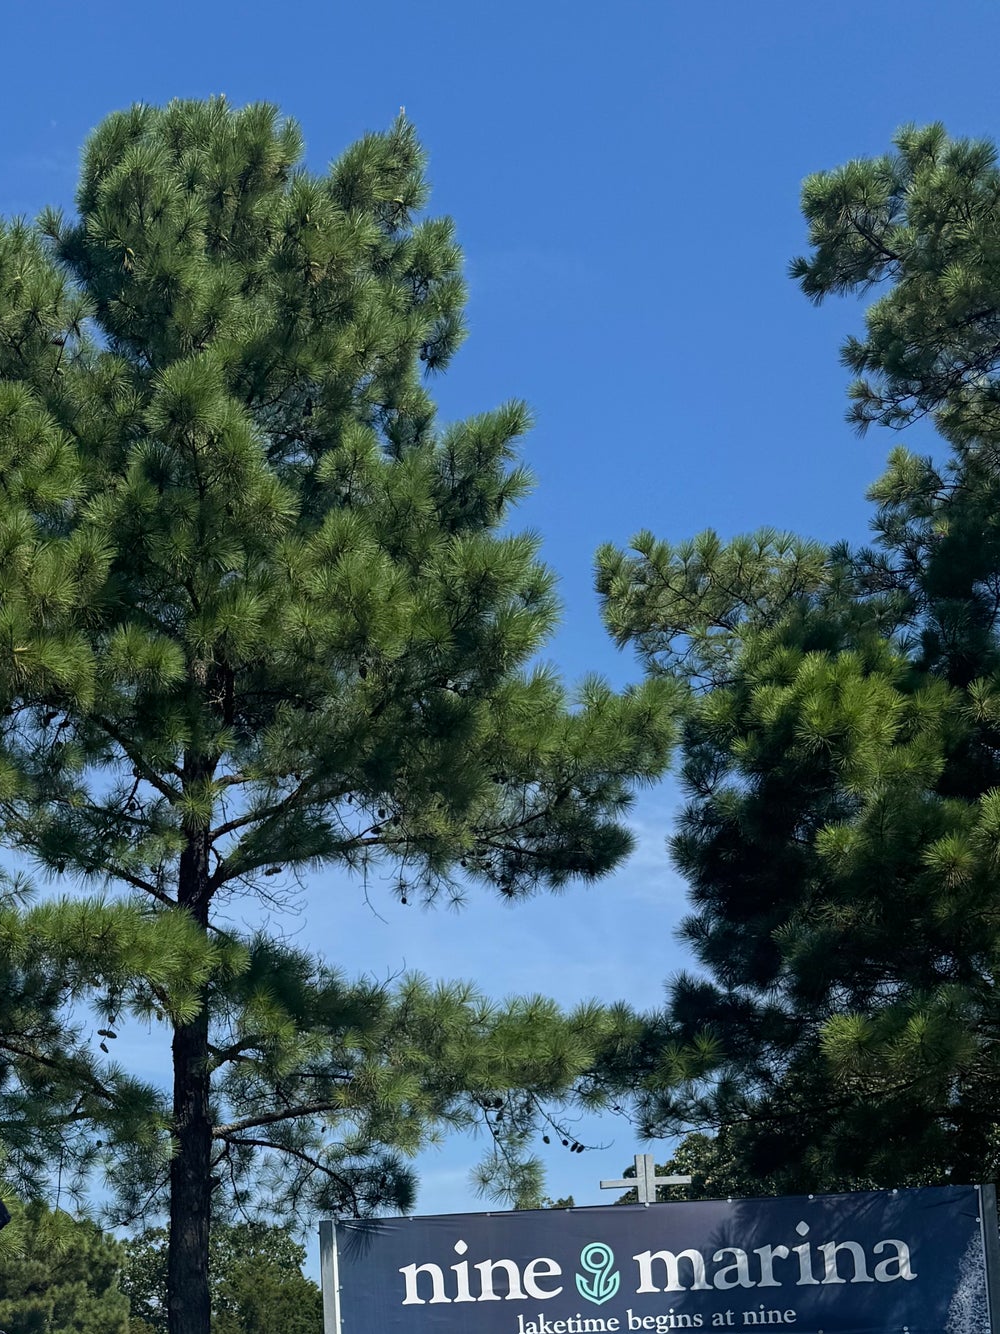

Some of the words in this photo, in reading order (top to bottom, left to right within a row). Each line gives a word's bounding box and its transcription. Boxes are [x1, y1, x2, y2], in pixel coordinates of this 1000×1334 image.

[398, 1239, 563, 1305] nine
[632, 1220, 918, 1294] marina
[626, 1307, 703, 1332] begins
[711, 1310, 735, 1327] at
[742, 1304, 797, 1326] nine
